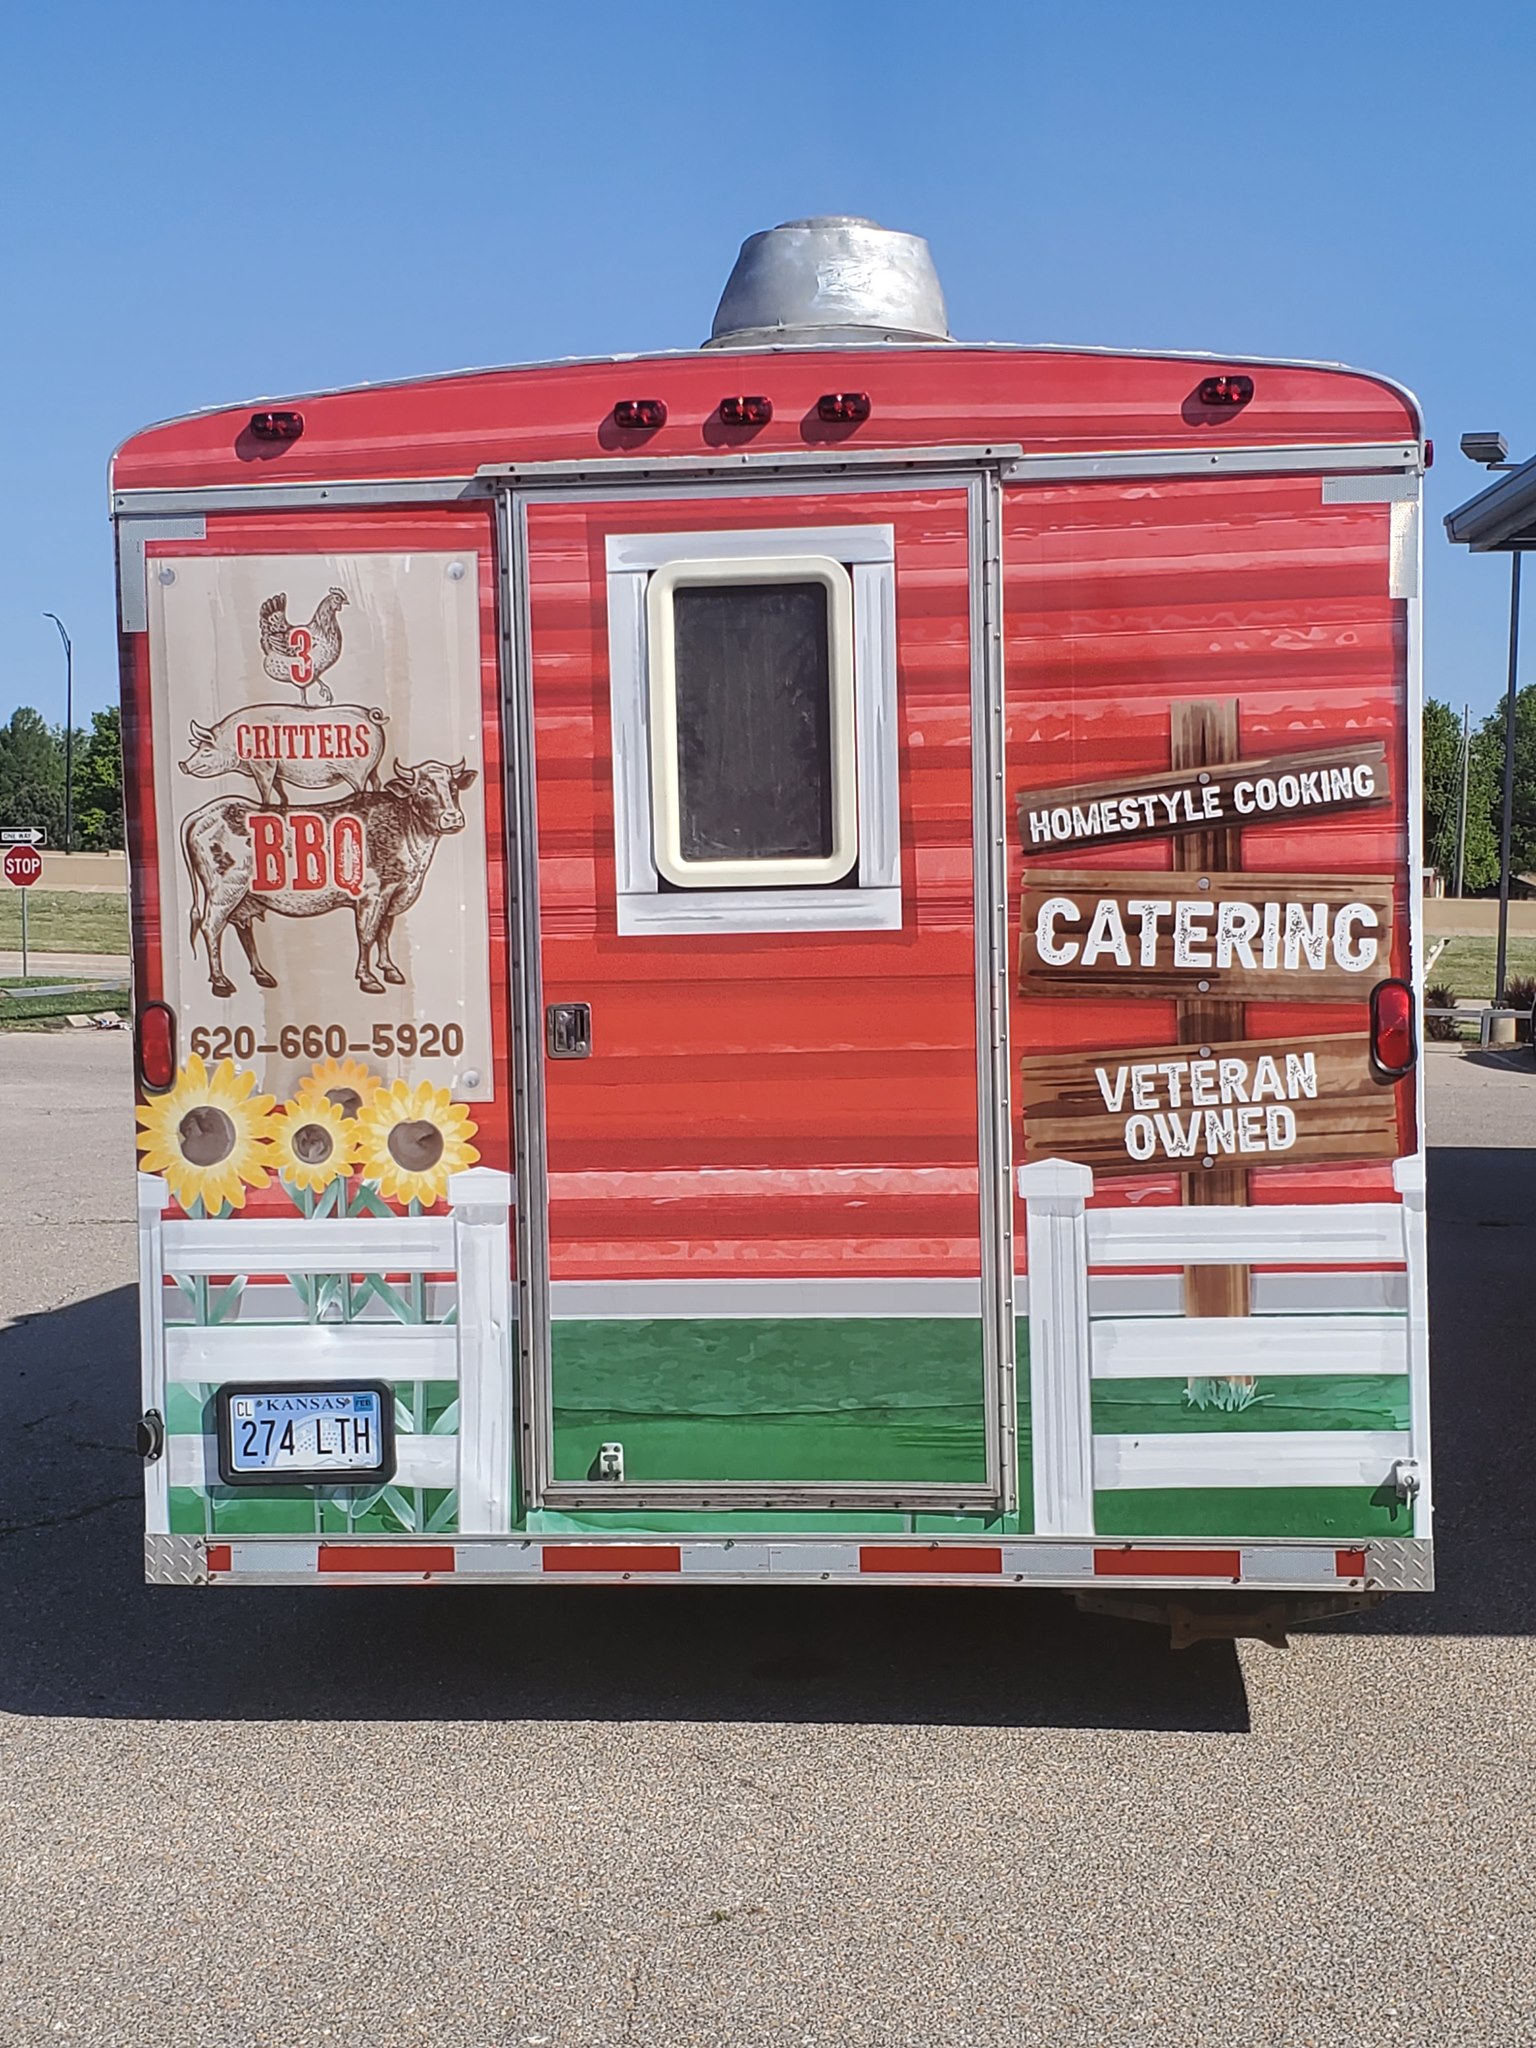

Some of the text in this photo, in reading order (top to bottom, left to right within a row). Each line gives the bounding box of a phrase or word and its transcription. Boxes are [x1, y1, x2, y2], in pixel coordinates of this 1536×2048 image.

[288, 627, 313, 684] 3
[236, 723, 371, 761] CRITTERS
[1028, 764, 1376, 844] HOMESTYLE COOKING
[5, 857, 41, 875] STOP
[248, 814, 363, 897] BBQ
[1035, 896, 1379, 972] CATERING
[190, 1022, 464, 1061] 620-660-5920
[1094, 1051, 1319, 1113] VETERAN
[1123, 1104, 1297, 1161] OWNED
[237, 1401, 253, 1417] CL
[266, 1397, 347, 1412] KANSAS
[241, 1417, 371, 1457] 274 LTH
